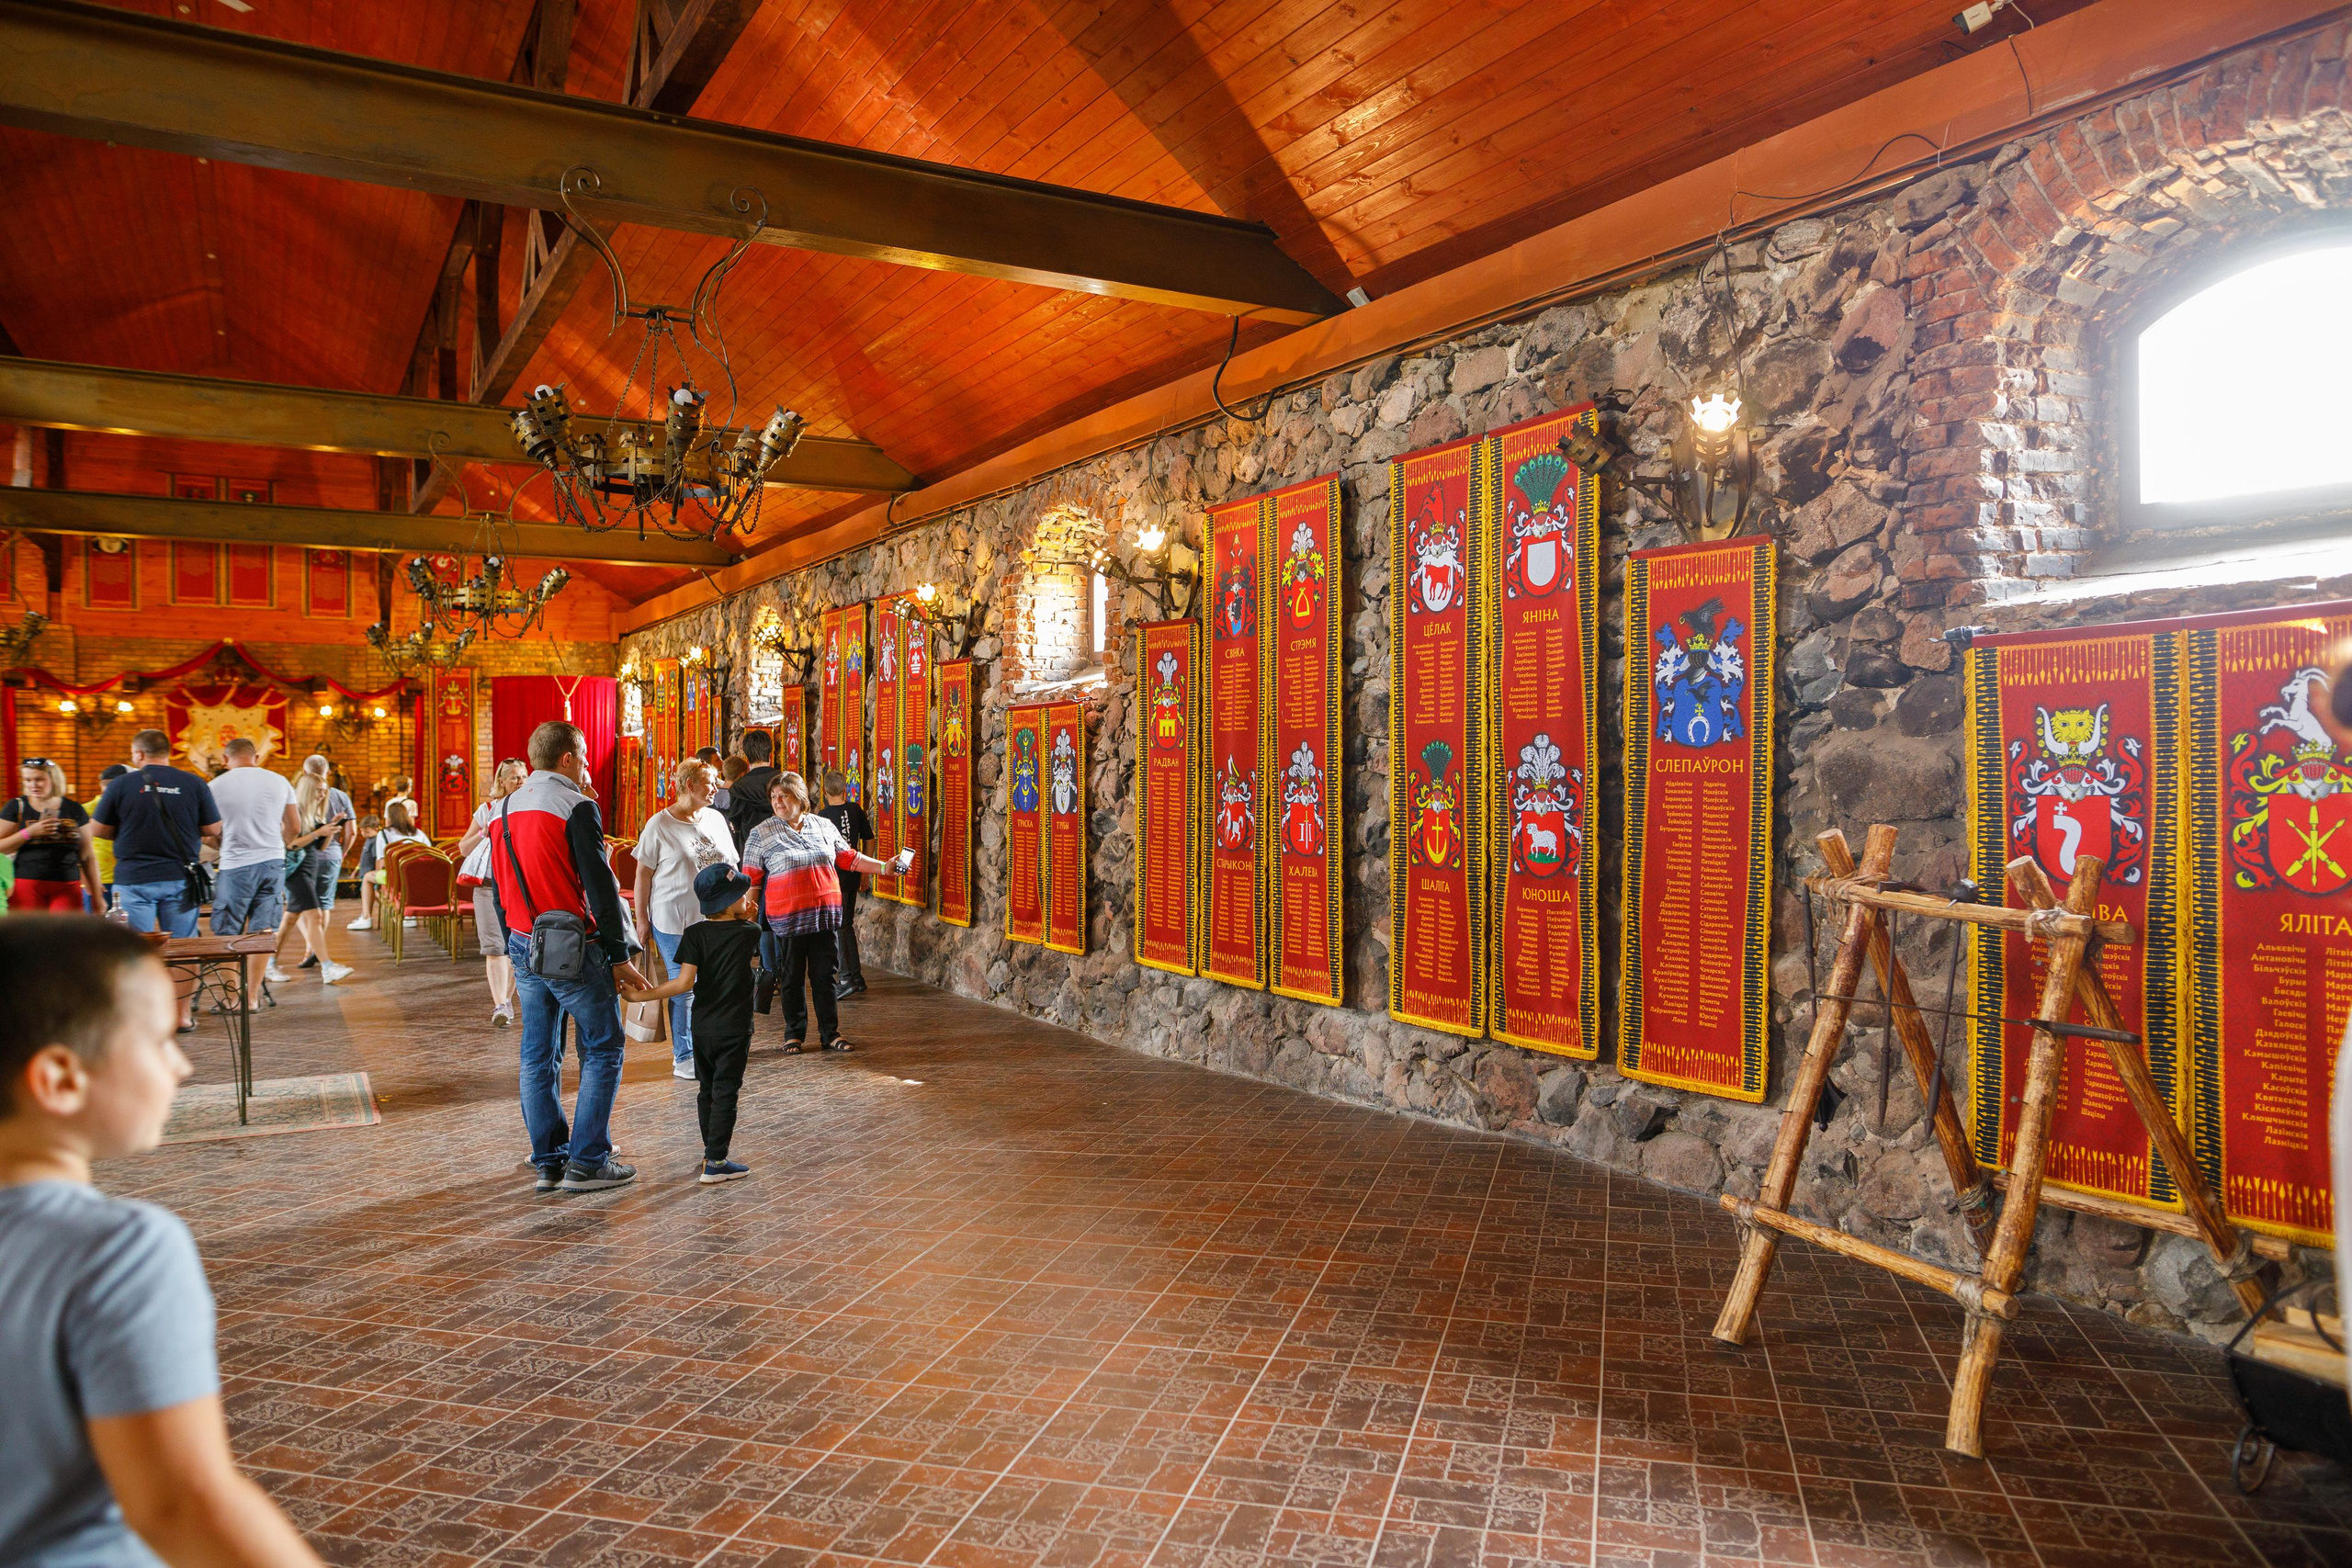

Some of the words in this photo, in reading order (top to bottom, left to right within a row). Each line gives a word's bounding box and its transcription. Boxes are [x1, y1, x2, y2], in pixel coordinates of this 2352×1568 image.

[1522, 608, 1559, 624] ЯНІНА
[1423, 622, 1451, 638] ЦЁЛАК
[1290, 637, 1317, 651] СТРЭМЯ
[1153, 757, 1180, 768] РАДВАН
[1656, 756, 1744, 773] СЛЕПАЎРОН
[1522, 887, 1571, 902] ЮНОША
[2279, 914, 2352, 936] ЯЛІТА
[2257, 943, 2306, 953] Алькевічы
[2251, 953, 2306, 964] Антановічы
[2254, 964, 2307, 975] Більчэўскія
[2279, 976, 2307, 986] Бурыя
[2262, 997, 2307, 1008] Валоўскія
[2274, 1009, 2306, 1018] Гаевічы
[2275, 1020, 2307, 1029] Галоскі
[2256, 1029, 2307, 1040] Дзядоўскія
[2256, 1040, 2307, 1051] Казялецкія
[2245, 1049, 2307, 1062] Камышоўскія
[2262, 1061, 2307, 1073] Капіевічы
[2272, 1073, 2307, 1084] Карыткі
[2263, 1083, 2307, 1095] Касоўскія
[2256, 1093, 2308, 1106] Квяткевічы
[2255, 1103, 2308, 1117] Кісялеўскія
[2243, 1112, 2308, 1128] Клюшчынскія
[2266, 1126, 2308, 1139] Лазінскія
[2265, 1136, 2308, 1149] Лазніцкія
